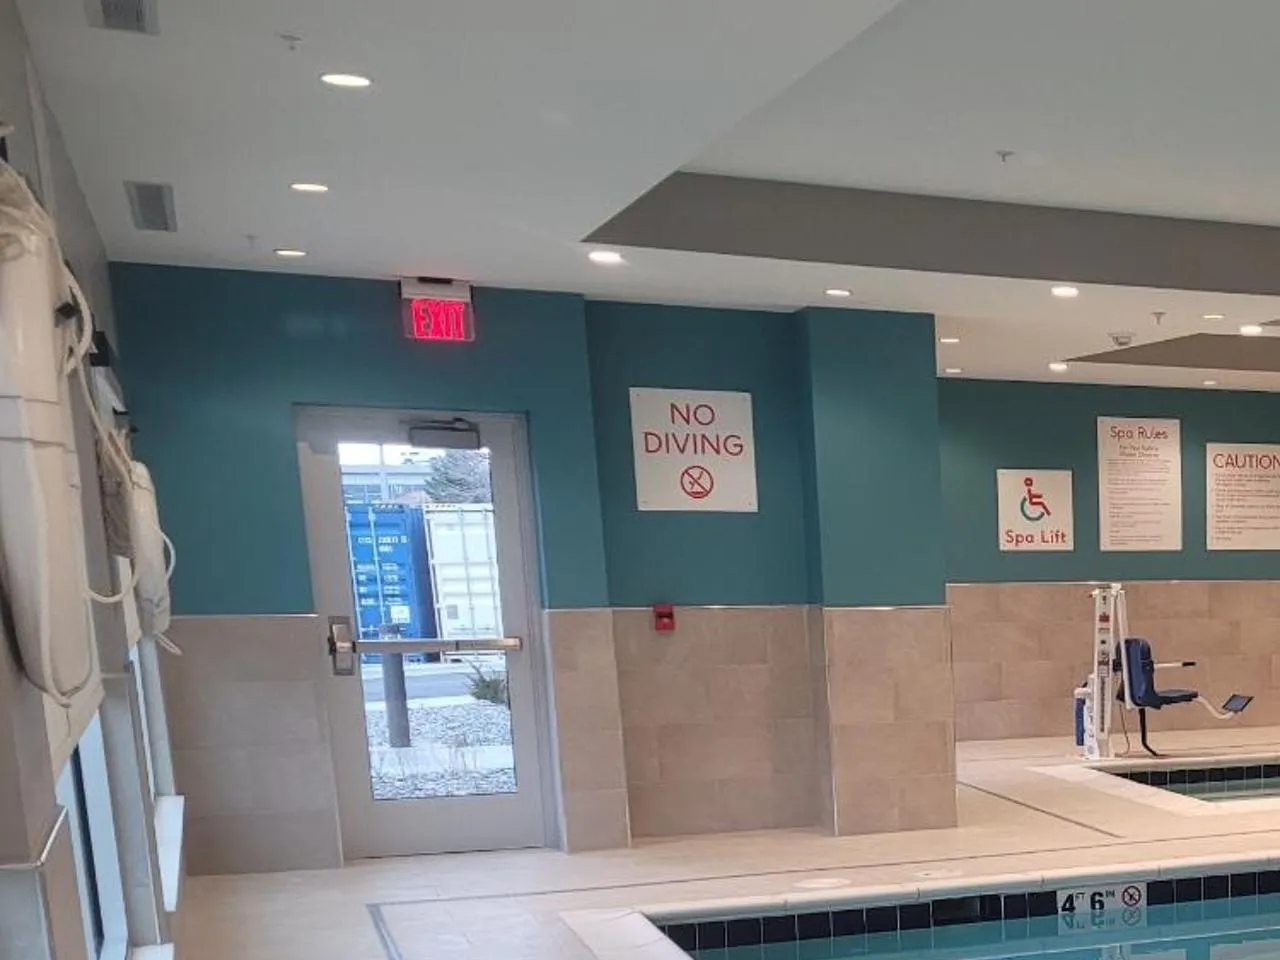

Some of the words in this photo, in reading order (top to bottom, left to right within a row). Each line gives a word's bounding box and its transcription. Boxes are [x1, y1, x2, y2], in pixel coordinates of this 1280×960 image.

[412, 301, 465, 339] EXIT
[670, 403, 715, 426] NO
[643, 431, 744, 456] DIVING
[1110, 425, 1133, 442] Spa
[1137, 425, 1168, 440] Rules
[1005, 529, 1034, 547] Spa
[1041, 529, 1067, 543] Lift
